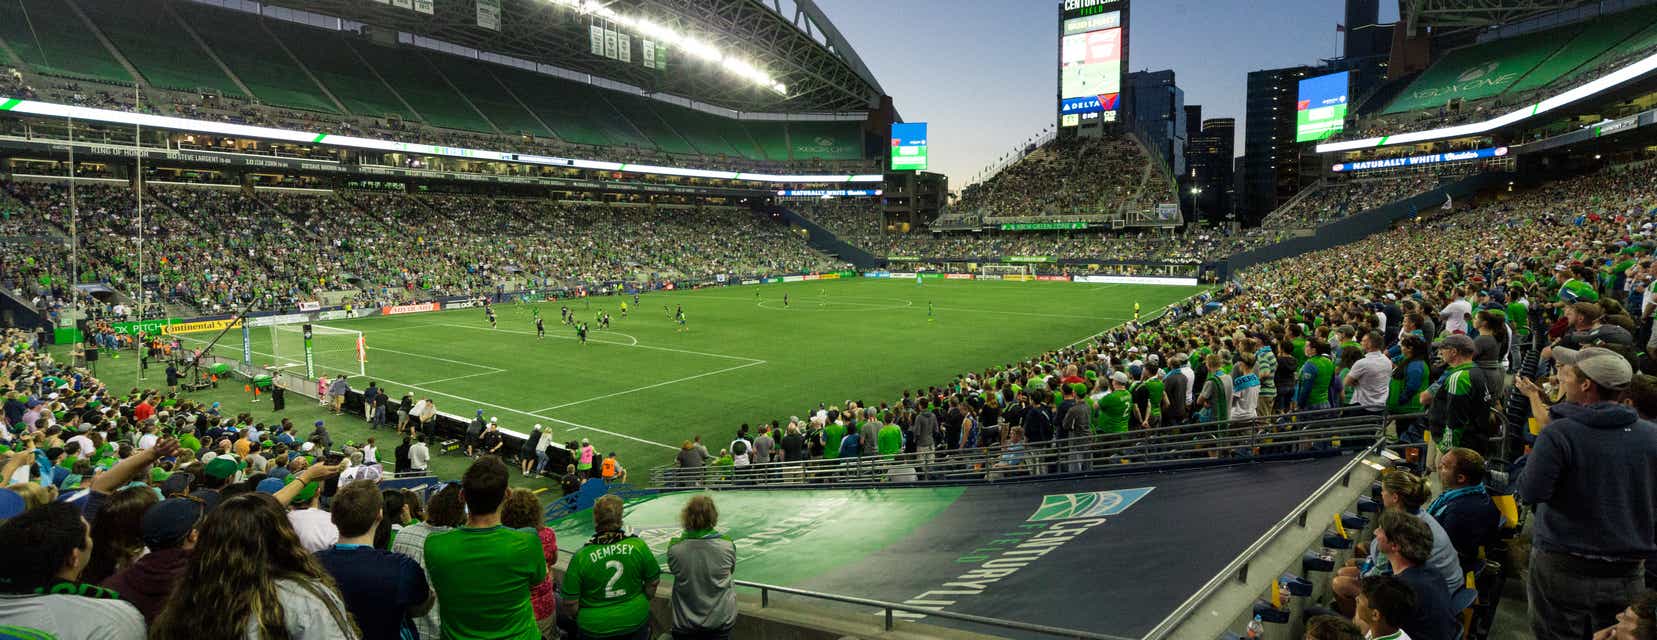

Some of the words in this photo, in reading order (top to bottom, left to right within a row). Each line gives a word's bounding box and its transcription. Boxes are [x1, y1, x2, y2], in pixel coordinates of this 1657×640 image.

[1064, 0, 1120, 11] CENTURYL
[1080, 4, 1103, 16] FIELD
[1071, 100, 1100, 110] DELTA
[112, 147, 121, 156] OF
[1353, 158, 1407, 170] NATURALLY
[1409, 154, 1441, 165] WHITE
[132, 322, 162, 334] PTCH
[590, 543, 634, 563] DEMPSEY
[874, 517, 1107, 622] CENTURYLIN
[604, 560, 627, 599] 2
